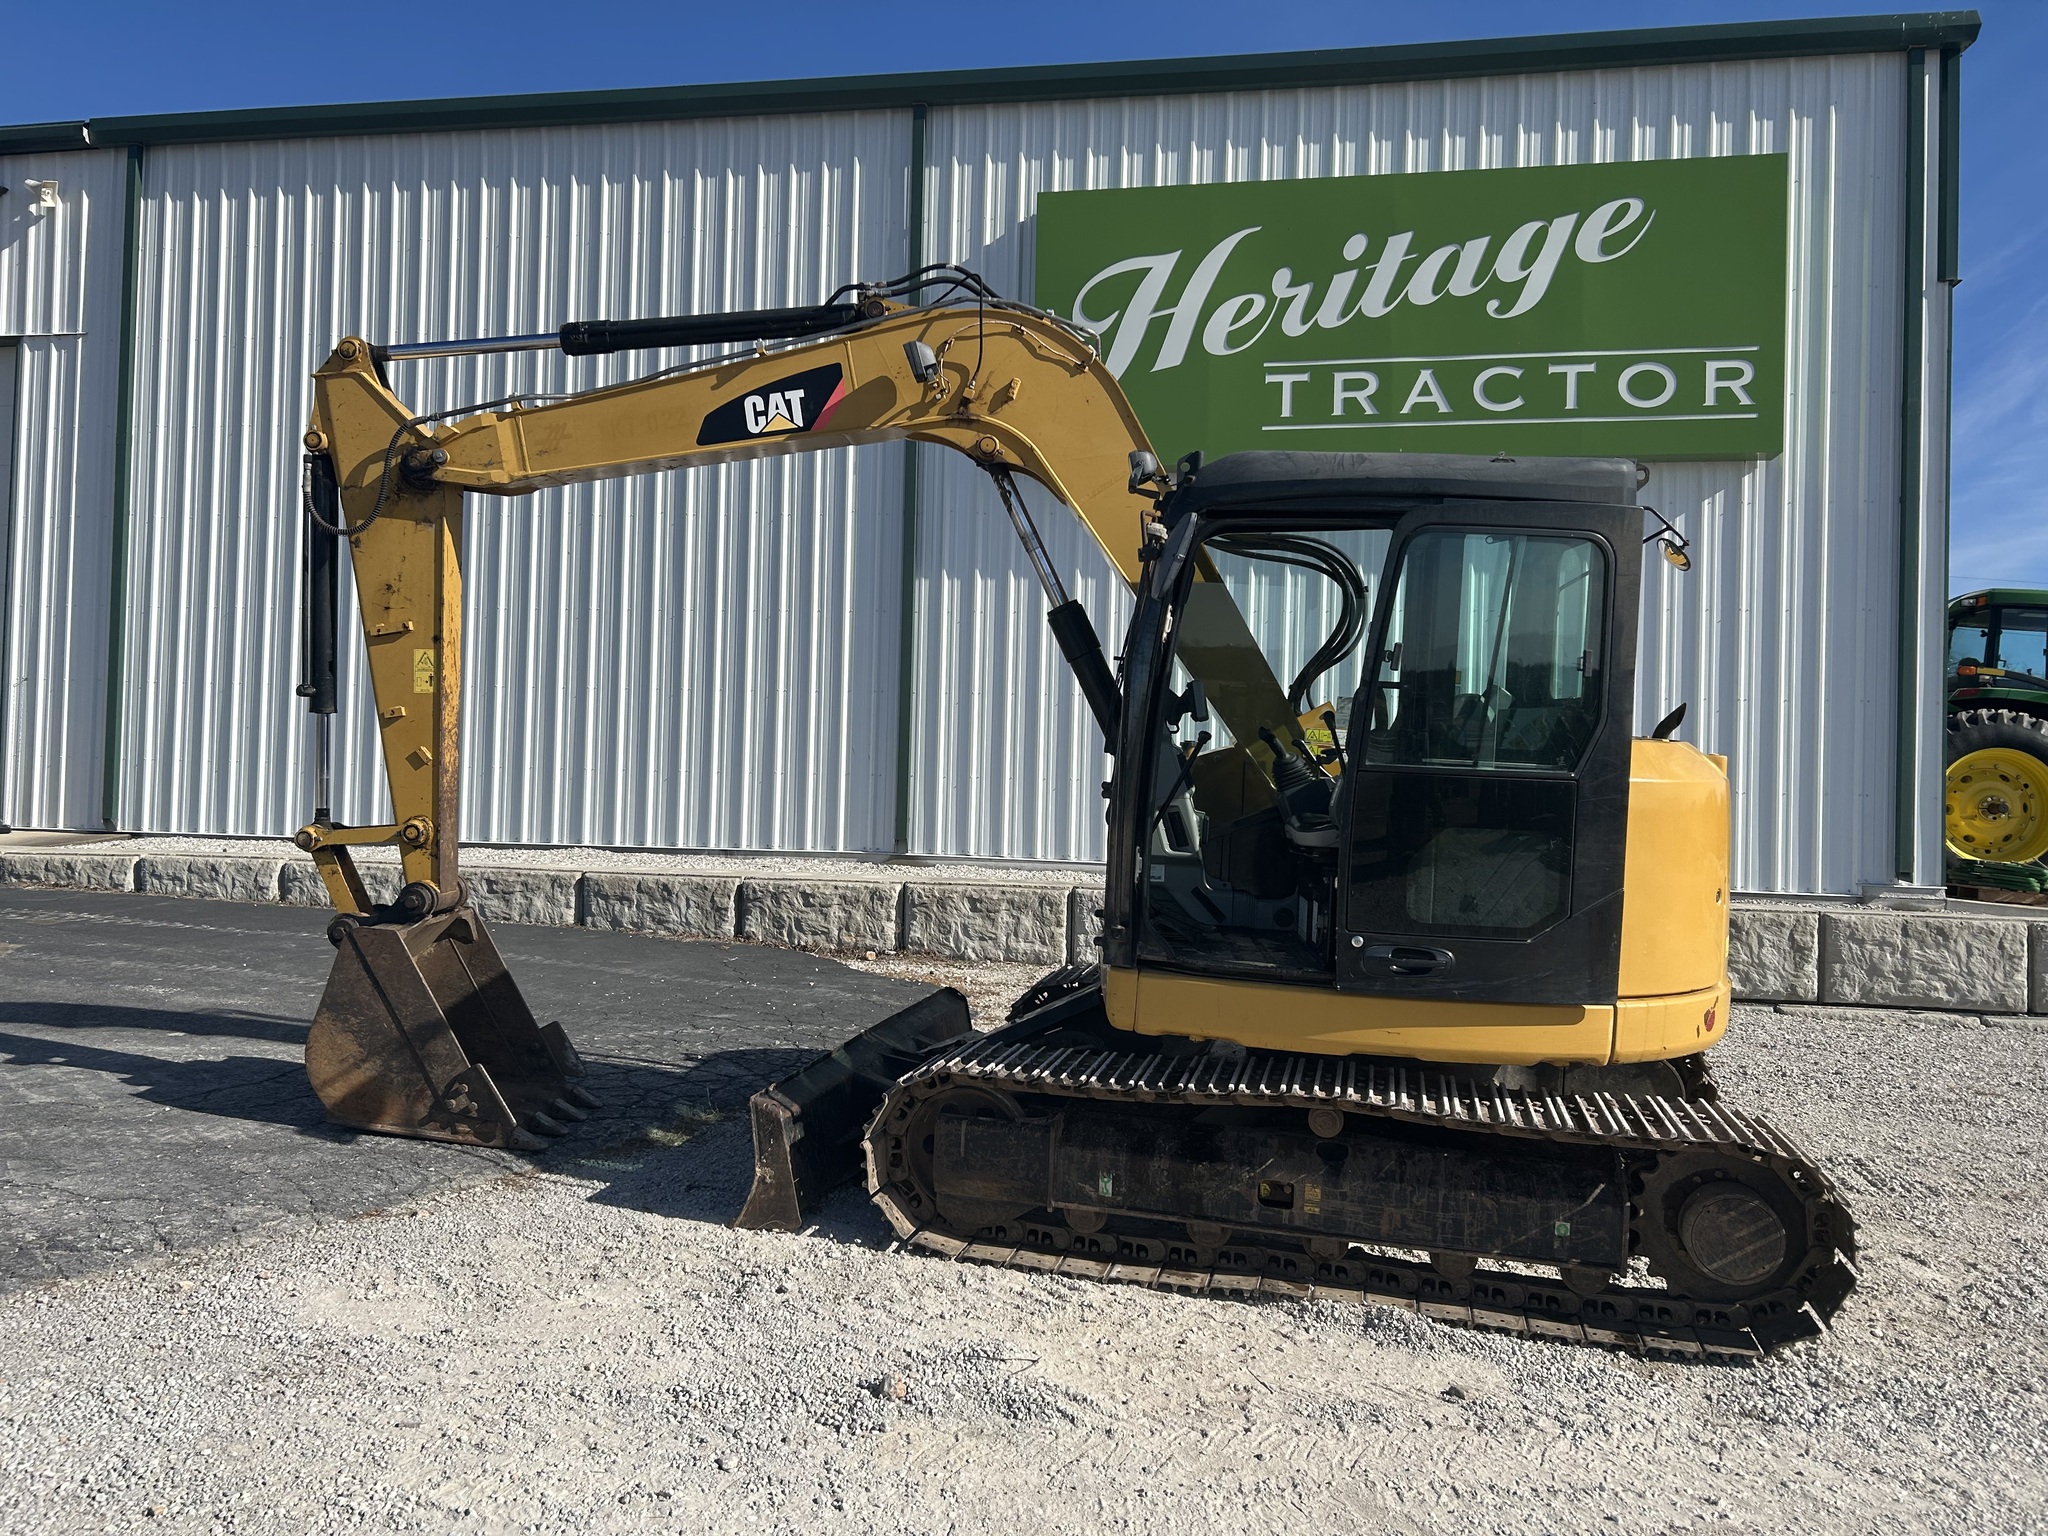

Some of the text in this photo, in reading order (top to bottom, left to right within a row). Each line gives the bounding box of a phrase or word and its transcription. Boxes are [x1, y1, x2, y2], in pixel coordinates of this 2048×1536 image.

[1071, 196, 1657, 381] Heritage
[743, 388, 806, 434] CAT
[1264, 358, 1756, 418] TRACTOR
